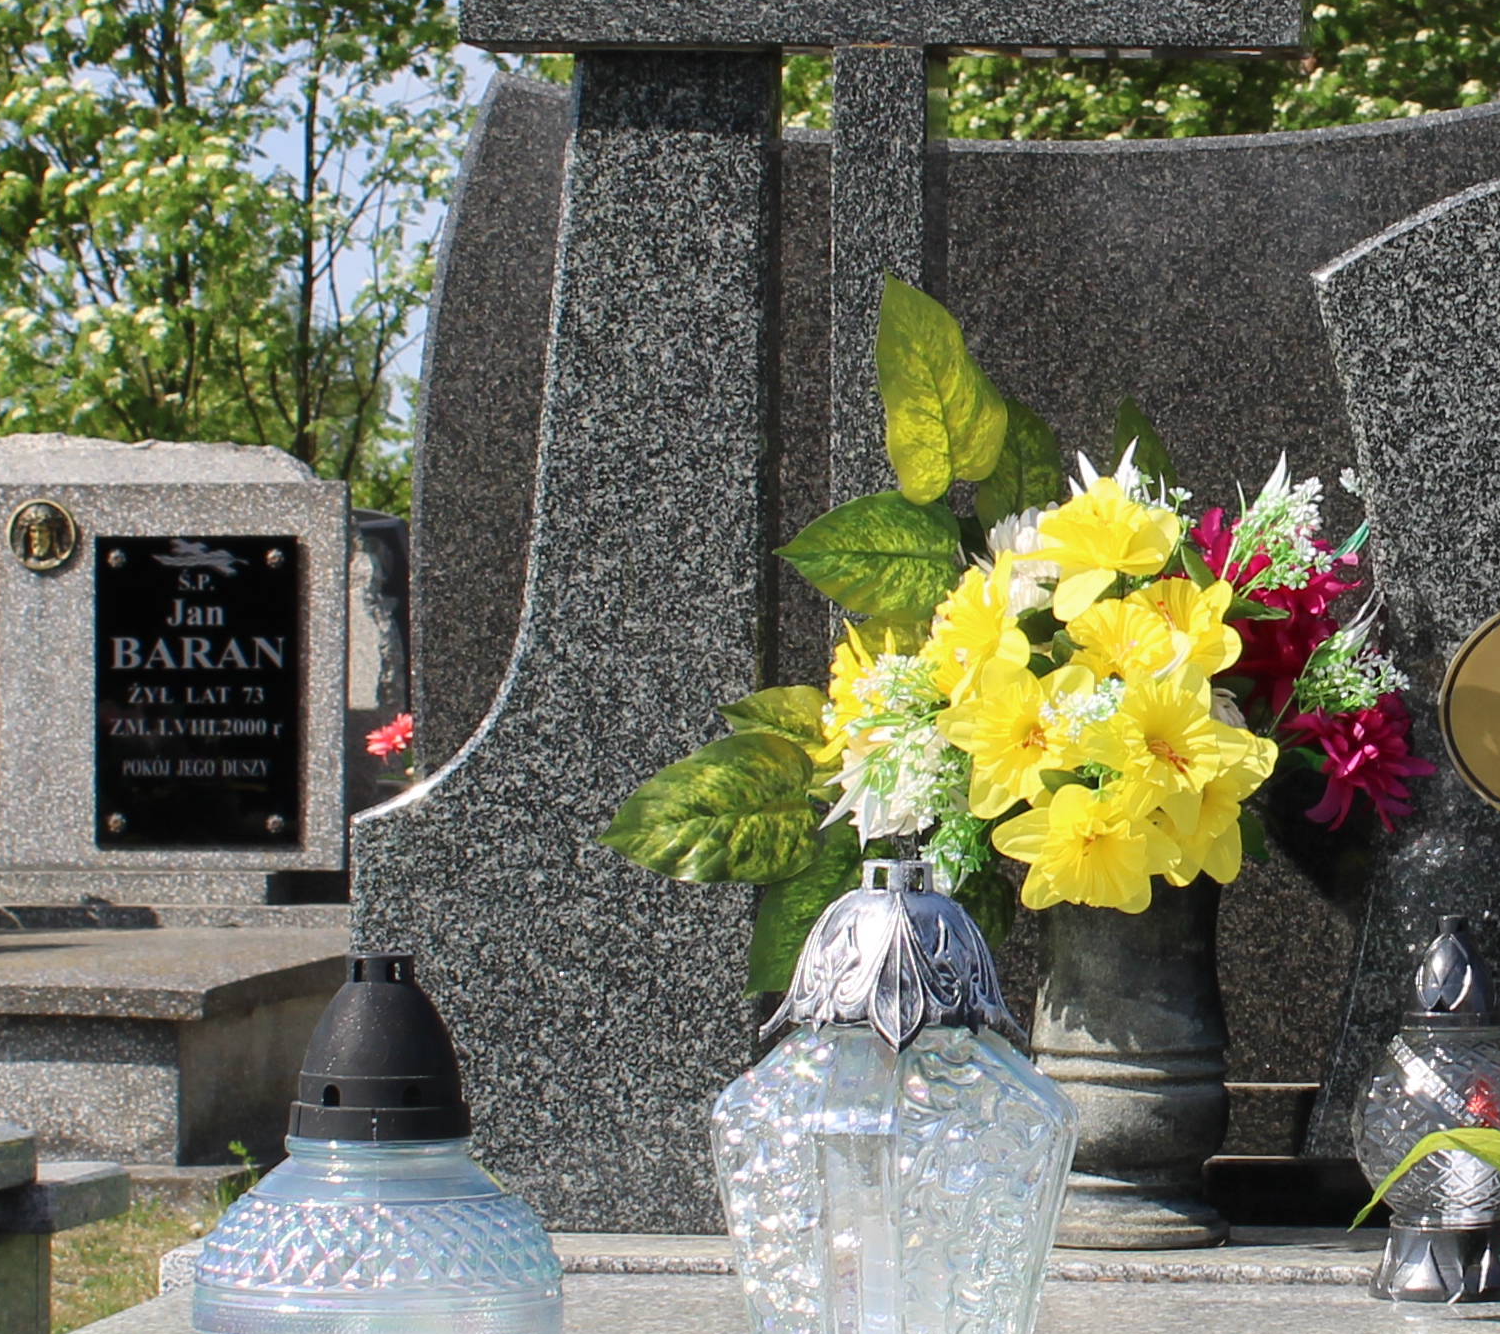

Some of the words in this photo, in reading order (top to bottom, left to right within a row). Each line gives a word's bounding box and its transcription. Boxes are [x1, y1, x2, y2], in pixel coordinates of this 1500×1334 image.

[178, 569, 215, 591] Ś.P.
[166, 599, 225, 627] Jan
[111, 637, 285, 669] BARAN
[127, 683, 174, 704] ŻYŁ
[185, 686, 231, 704] LAT
[242, 686, 265, 704] 73
[110, 719, 150, 736] ZM.
[176, 759, 215, 777] JEGO
[222, 759, 270, 777] DUSZY
